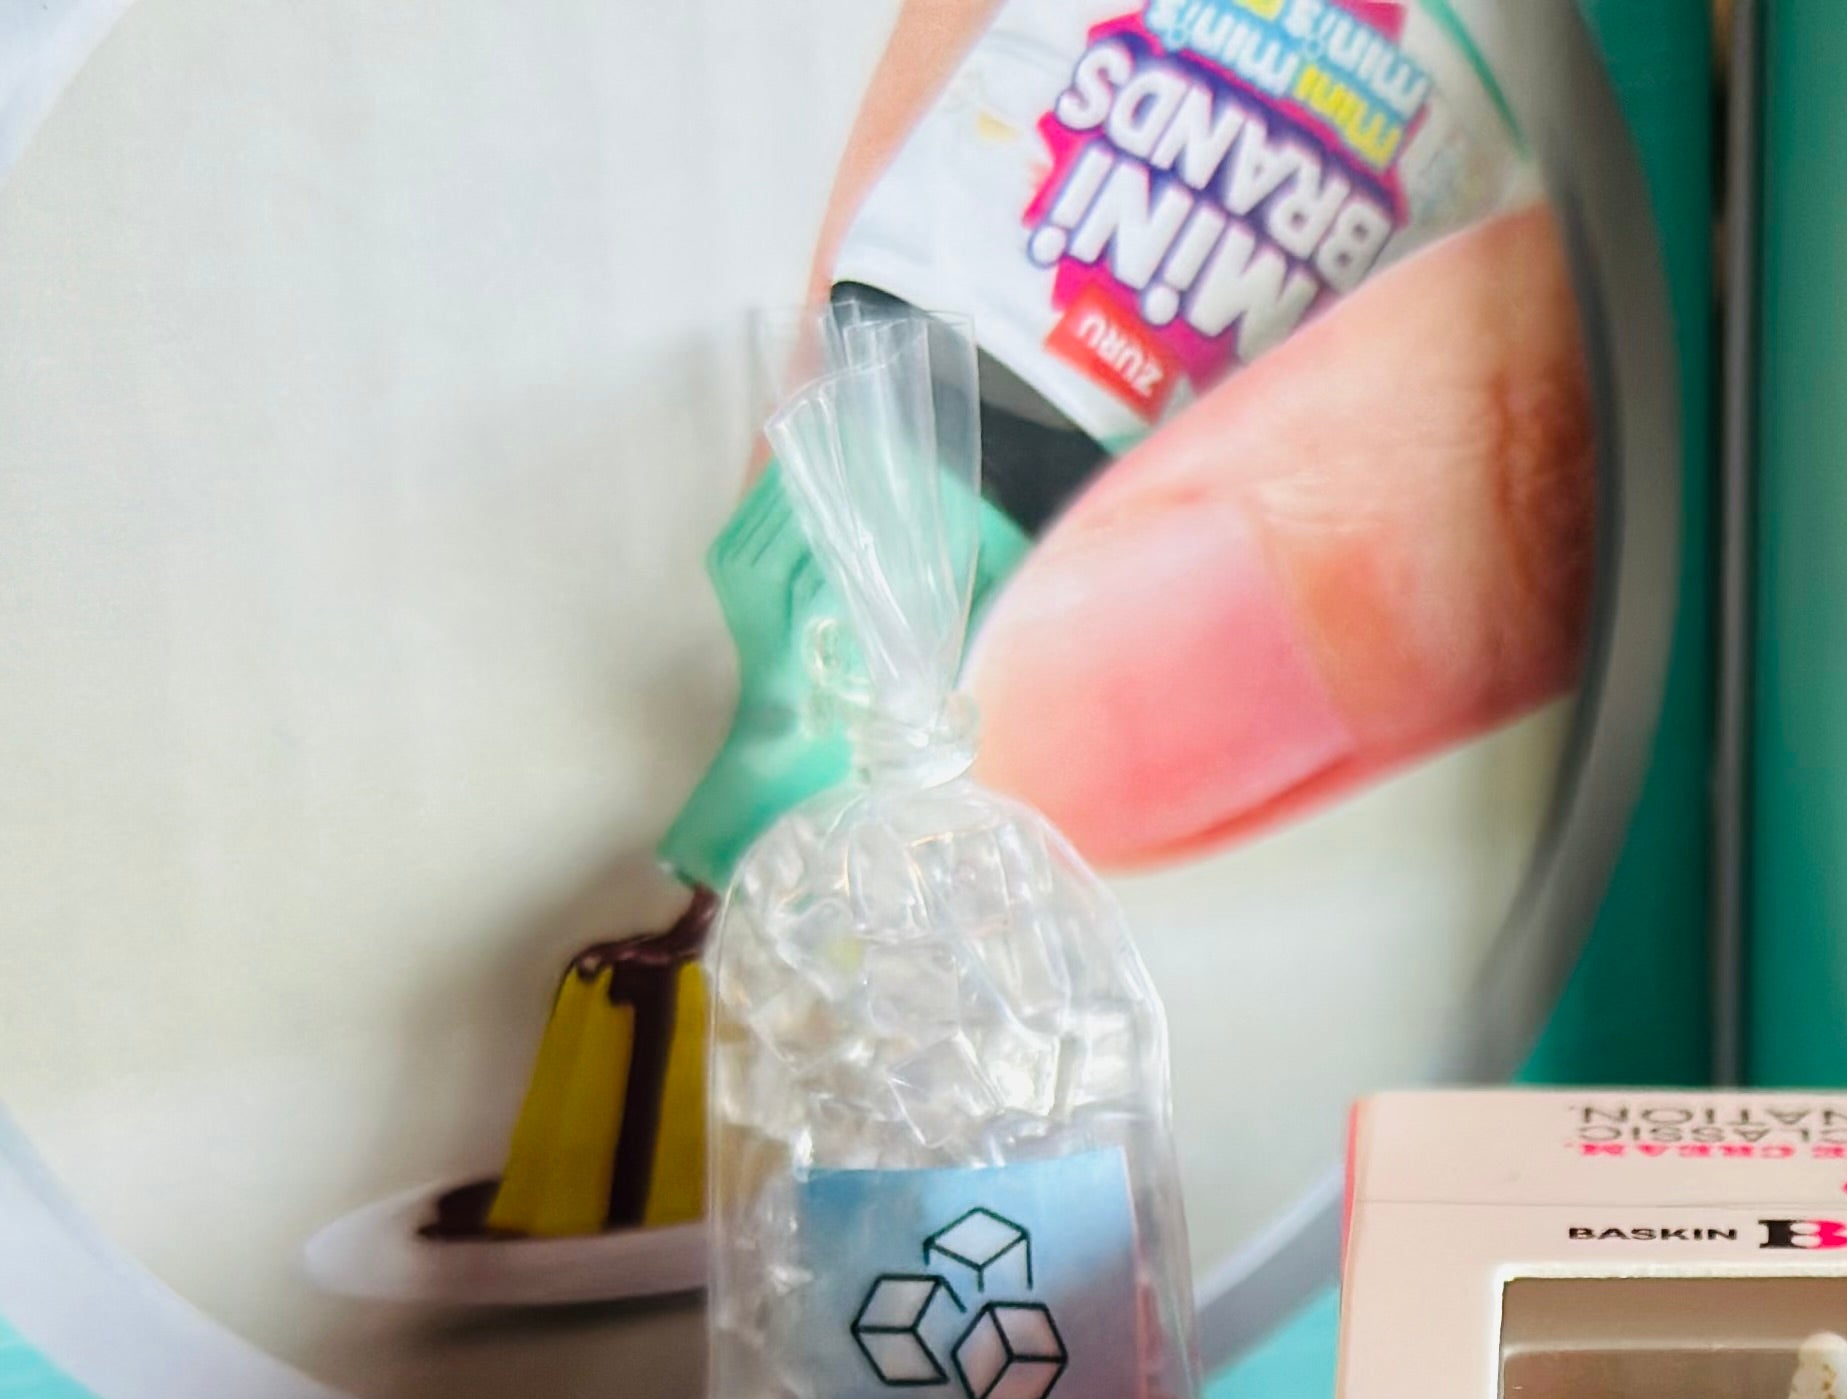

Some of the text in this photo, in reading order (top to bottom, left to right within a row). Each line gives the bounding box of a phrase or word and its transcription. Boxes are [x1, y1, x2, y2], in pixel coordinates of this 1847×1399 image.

[1055, 44, 1393, 295] BRANDS
[1074, 310, 1165, 400] ZURU
[1567, 1226, 1739, 1242] BASKIN
